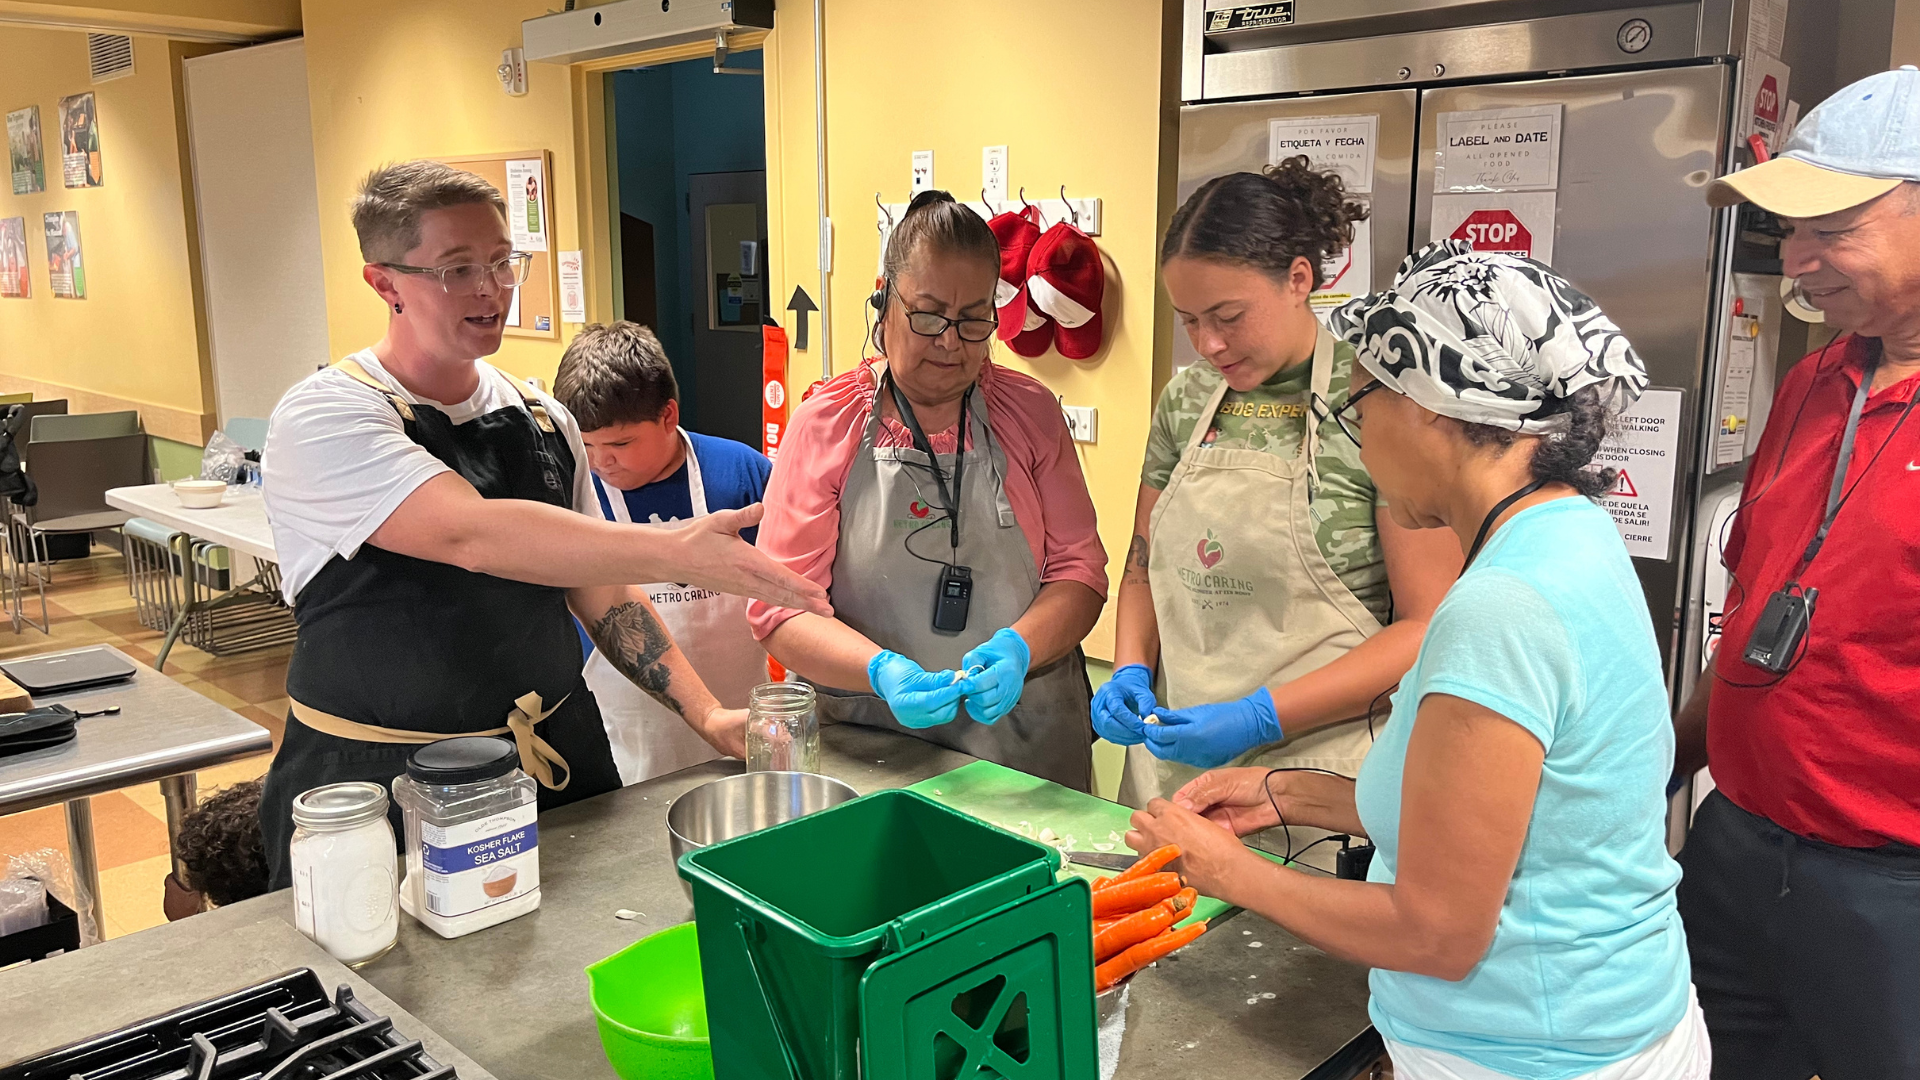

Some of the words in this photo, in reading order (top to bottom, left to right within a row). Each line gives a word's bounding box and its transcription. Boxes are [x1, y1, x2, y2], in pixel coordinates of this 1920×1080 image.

[1242, 17, 1286, 26] REFRIGERATOR
[1760, 88, 1776, 112] STOP
[1480, 121, 1518, 130] PLEASE
[1280, 139, 1321, 149] ETIQUETA
[1335, 137, 1365, 147] FECHA
[1450, 136, 1489, 147] LABEL
[1493, 135, 1511, 143] AND
[1515, 131, 1548, 143] DATE
[1489, 150, 1530, 159] OPENED
[1483, 160, 1511, 168] FOOD
[1465, 223, 1518, 243] STOP
[1220, 401, 1255, 417] BUG
[1619, 415, 1639, 423] LEFT
[1640, 416, 1665, 425] DOOR
[766, 422, 780, 445] DO
[1621, 424, 1660, 433] WALKING
[1603, 446, 1628, 454] WHEN
[1629, 447, 1666, 457] CLOSING
[1605, 454, 1629, 462] DOOR
[1608, 500, 1619, 508] DE
[1620, 501, 1637, 509] QUE
[1638, 503, 1649, 511] LA
[1636, 511, 1646, 519] SE
[1624, 518, 1650, 527] SALIR!
[1624, 533, 1653, 543] CIERRE
[1204, 574, 1254, 592] CARING
[649, 592, 682, 604] METRO
[467, 839, 502, 855] KOSHER
[502, 830, 526, 845] FLAKE
[474, 851, 497, 865] SEA
[497, 842, 521, 858] SALT
